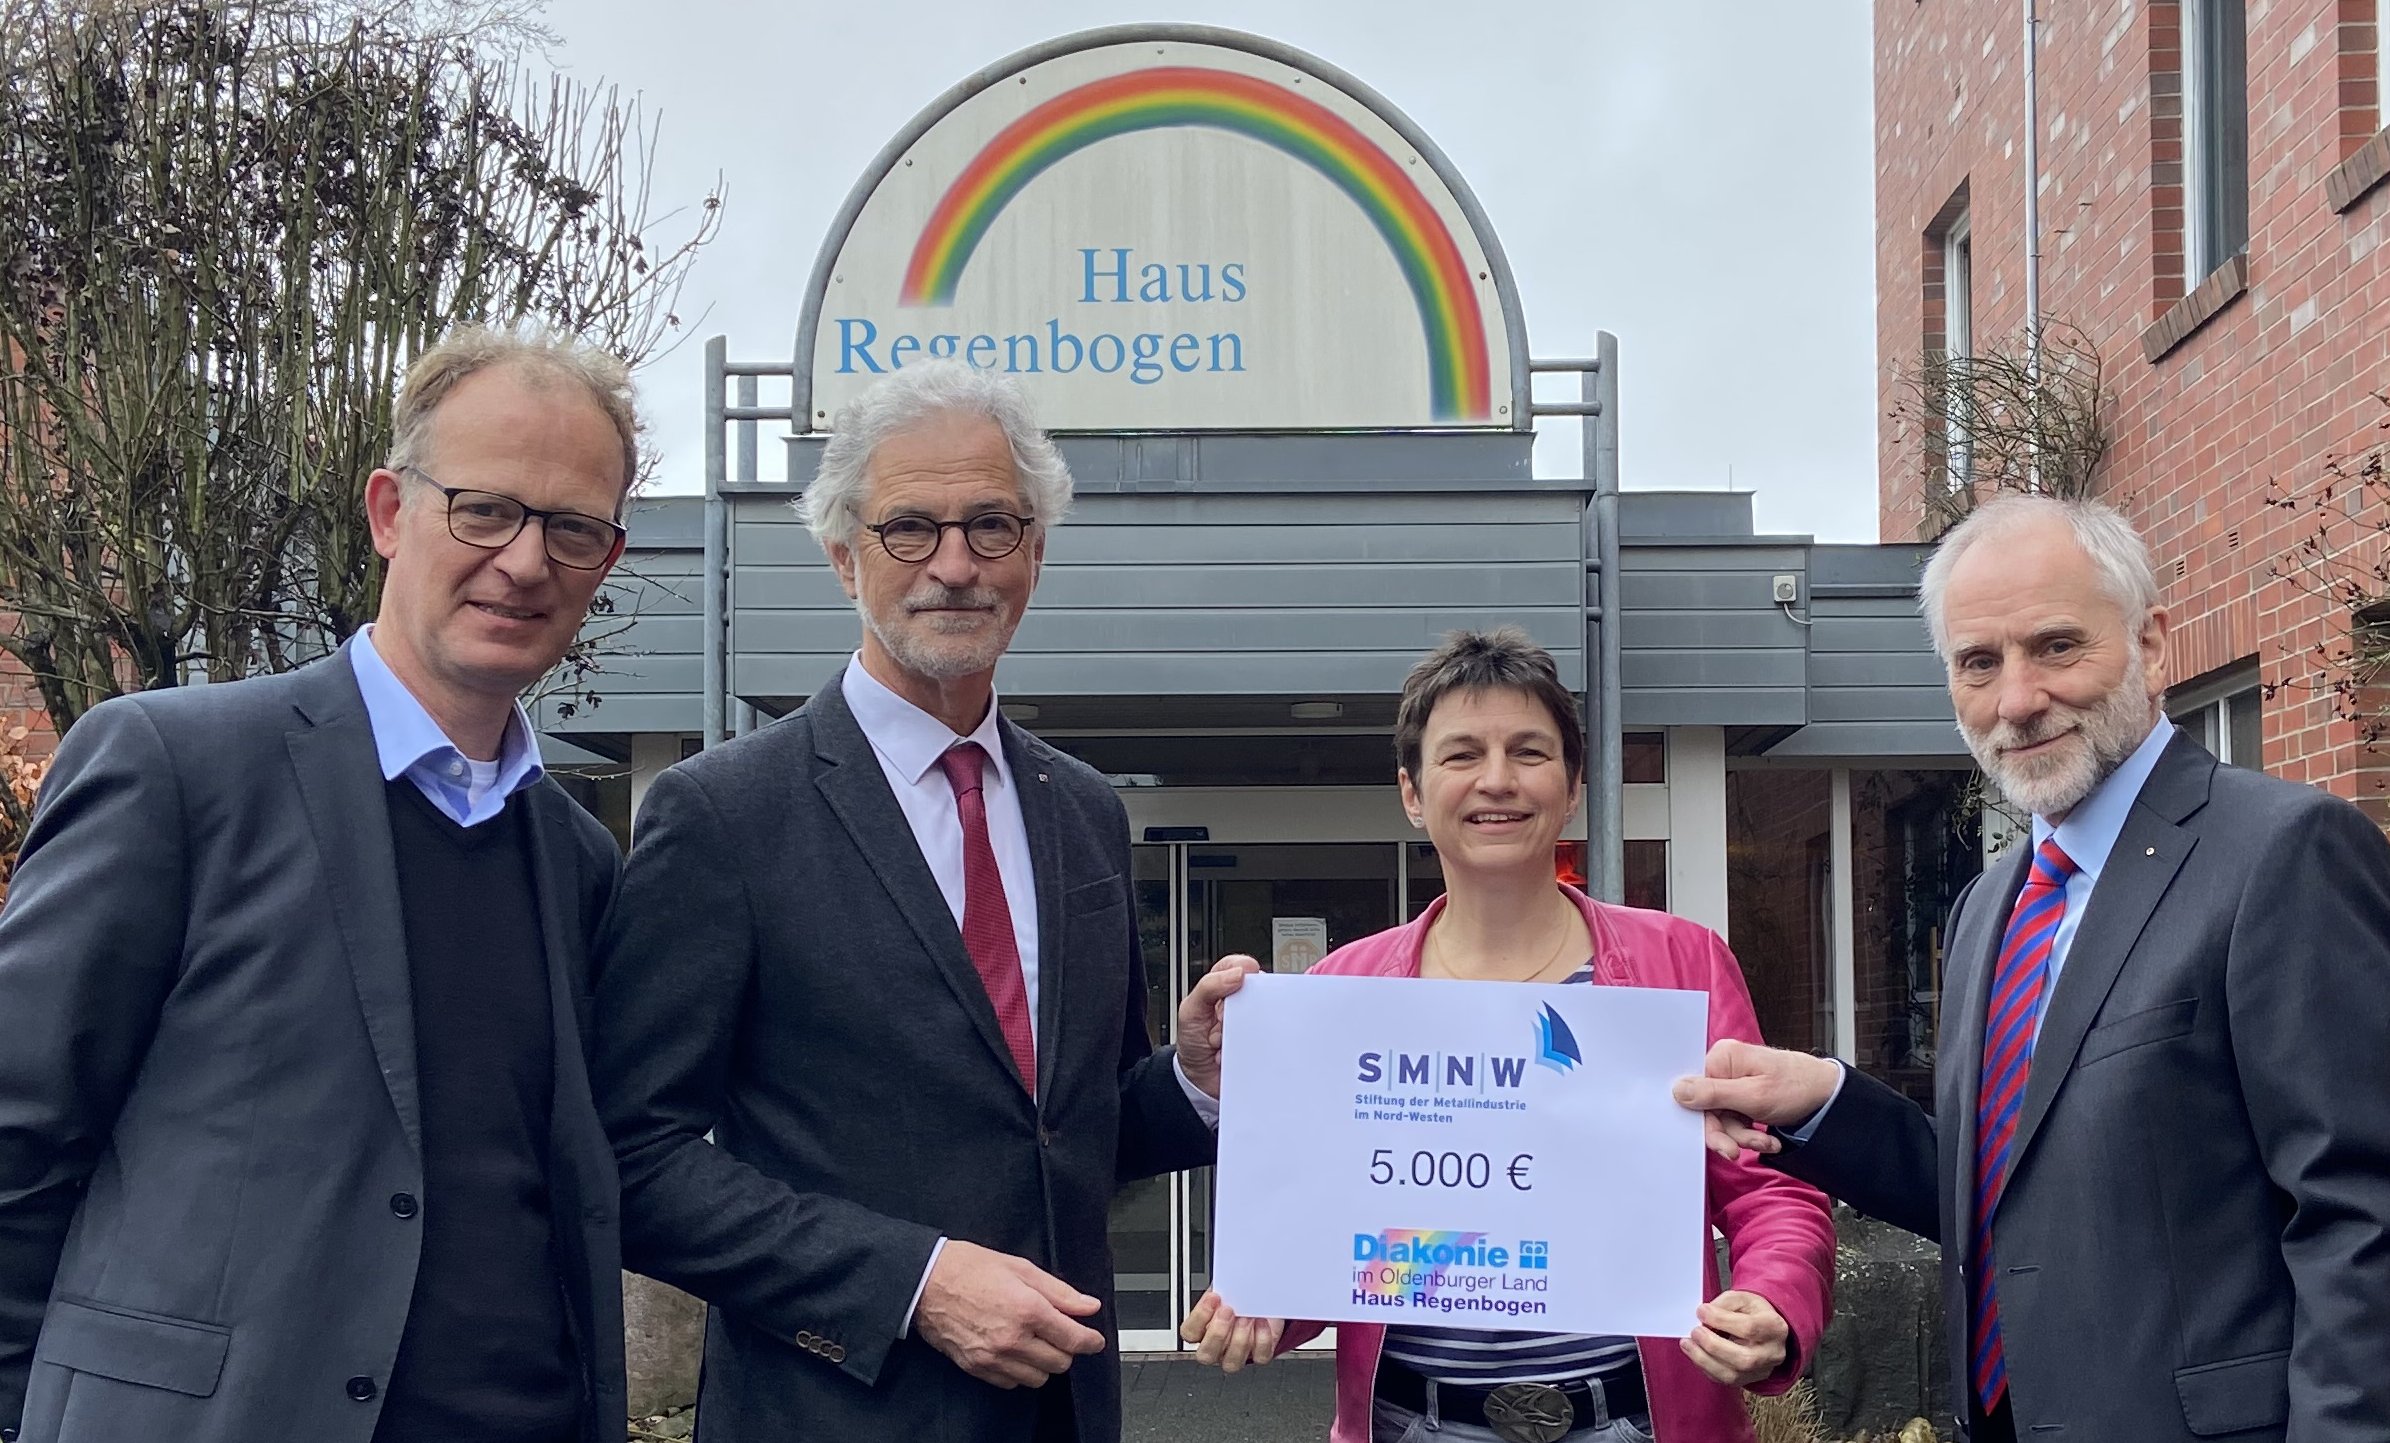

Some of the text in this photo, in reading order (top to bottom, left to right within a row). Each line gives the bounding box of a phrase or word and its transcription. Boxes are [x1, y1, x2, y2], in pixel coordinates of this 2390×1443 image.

[1077, 247, 1247, 304] Haus
[1354, 1093, 1528, 1112] Stiftung der Metallindustrie
[1354, 1109, 1454, 1124] im Nord-Westen
[1368, 1148, 1535, 1192] 5.000 €
[1353, 1232, 1510, 1269] Diakonie
[1351, 1266, 1549, 1294] im Oldenburger Land
[1351, 1288, 1548, 1317] Haus Regenbogen
